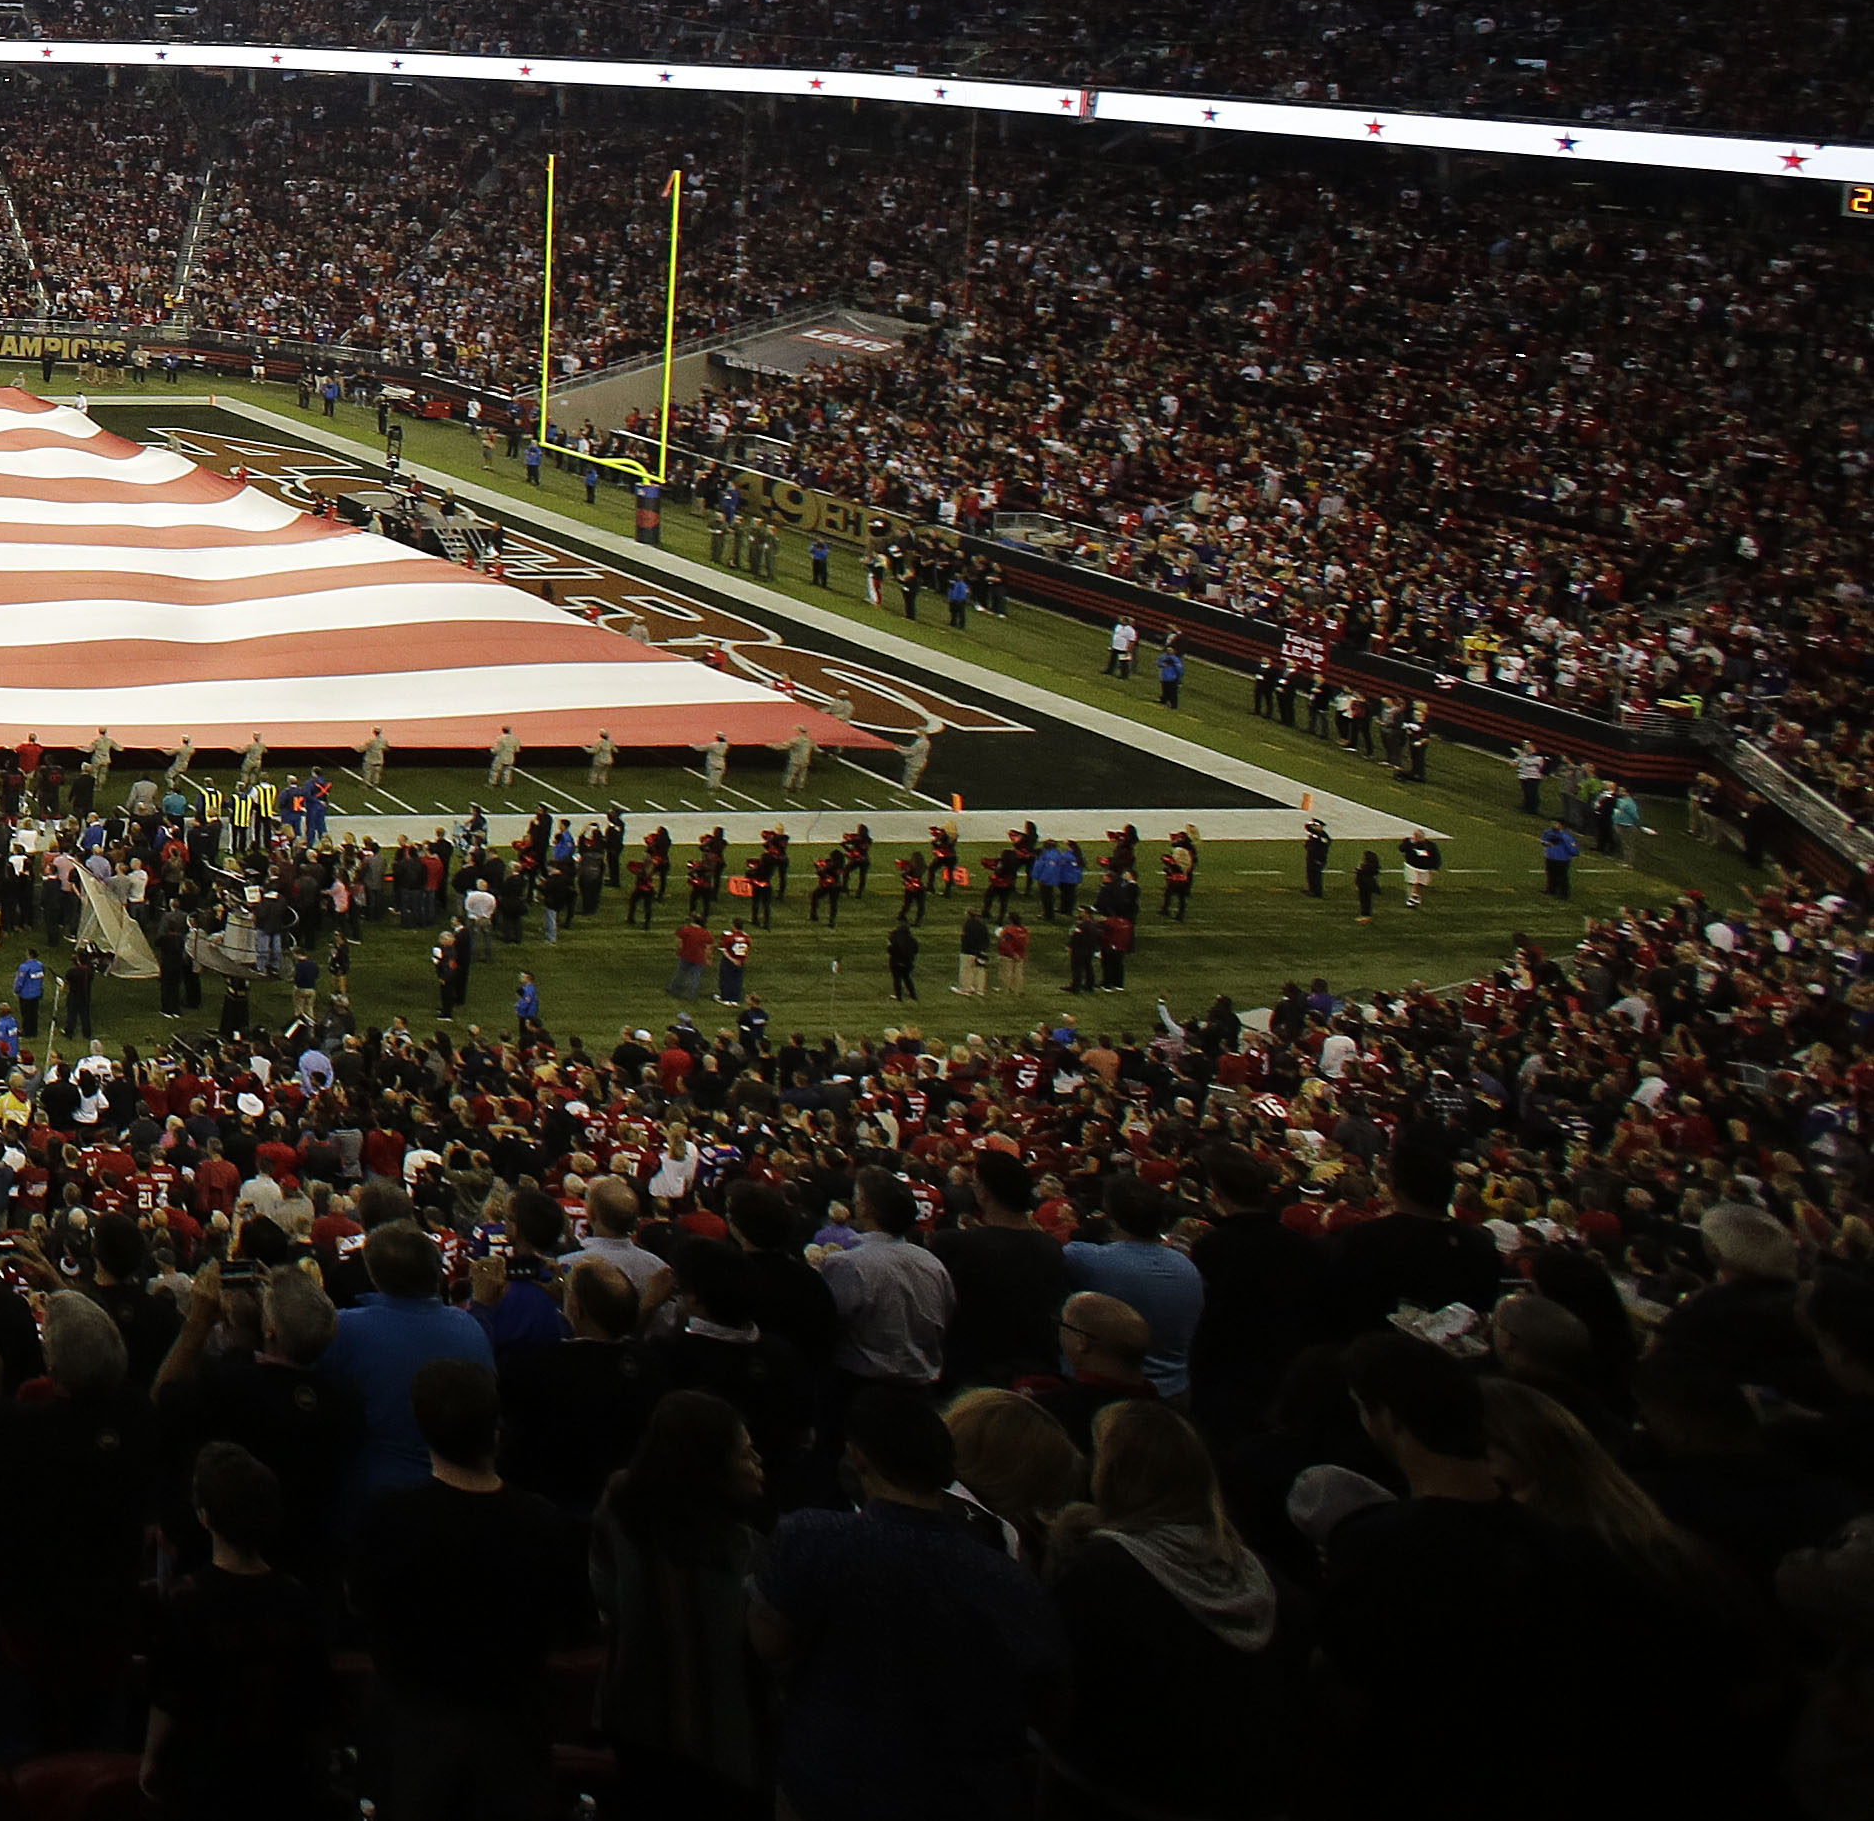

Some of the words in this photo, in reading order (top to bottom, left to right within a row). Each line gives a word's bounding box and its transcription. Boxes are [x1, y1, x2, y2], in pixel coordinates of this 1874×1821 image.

[1281, 643, 1325, 665] LEAP
[1257, 1097, 1287, 1118] 16
[137, 1191, 153, 1209] 21
